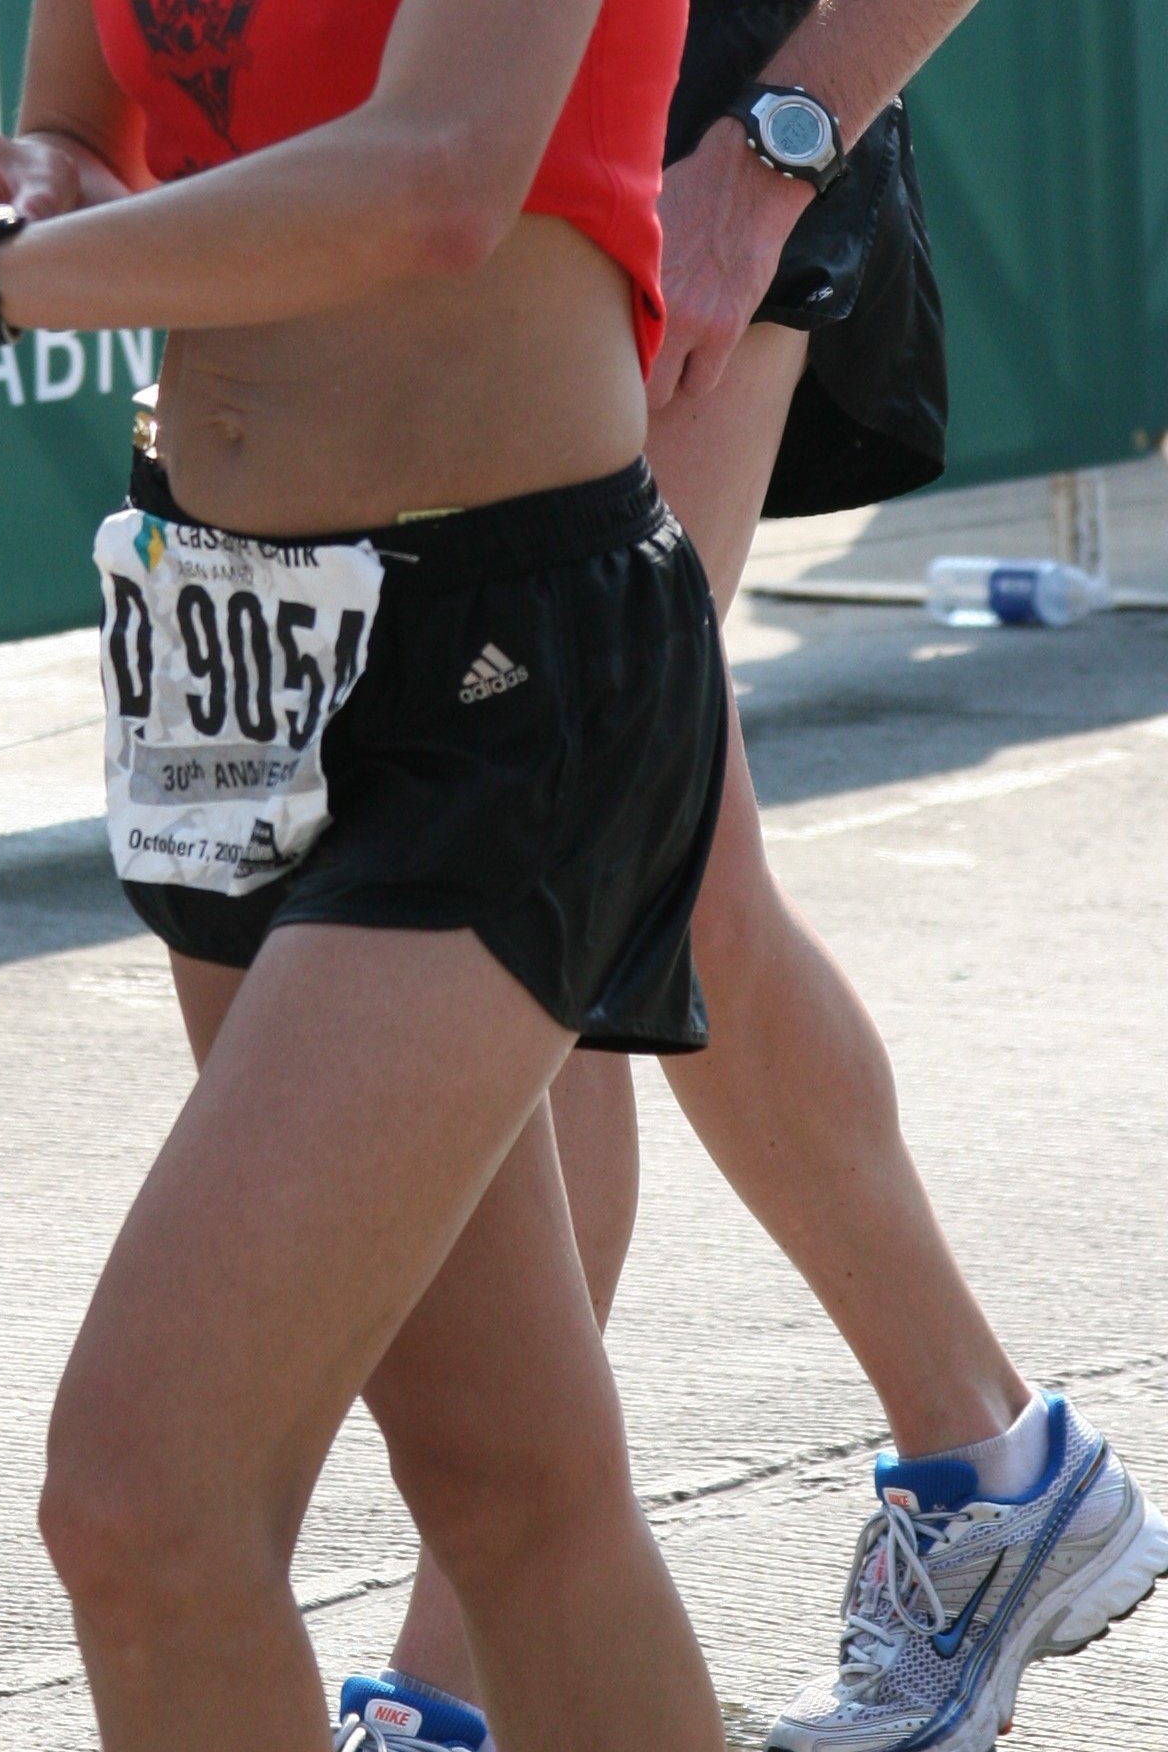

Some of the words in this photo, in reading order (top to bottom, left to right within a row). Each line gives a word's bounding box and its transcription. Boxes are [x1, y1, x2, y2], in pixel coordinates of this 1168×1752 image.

[109, 573, 153, 718] D
[459, 664, 529, 704] adidas
[162, 759, 205, 791] 30th
[128, 826, 194, 858] October
[373, 1704, 412, 1727] NIKE
